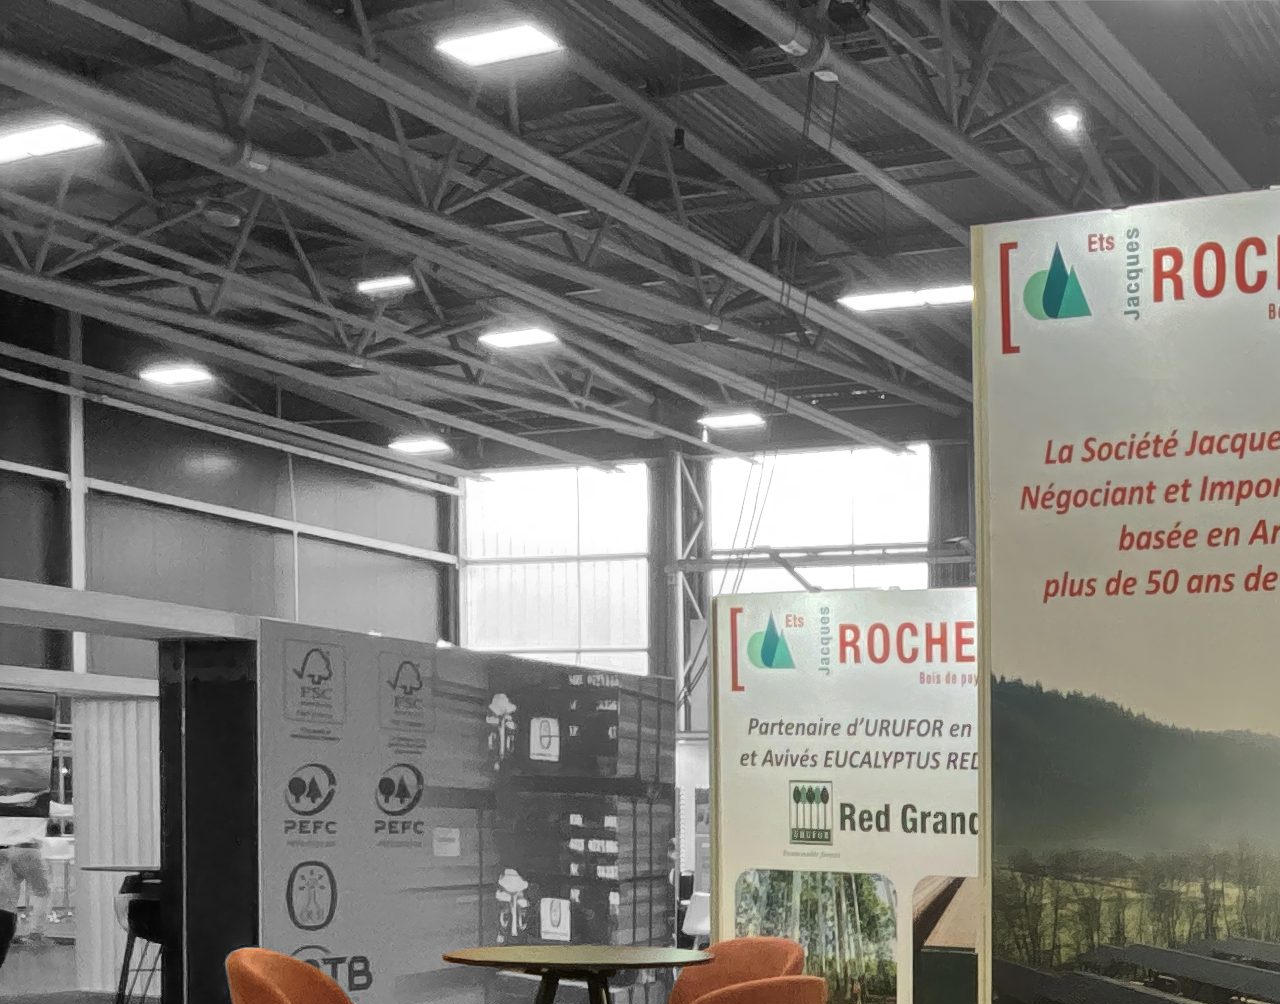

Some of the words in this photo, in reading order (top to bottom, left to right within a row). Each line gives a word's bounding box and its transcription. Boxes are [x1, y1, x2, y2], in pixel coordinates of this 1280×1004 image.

[1088, 234, 1114, 252] Ets
[1123, 228, 1143, 322] Jacques
[1045, 440, 1073, 464] La
[1081, 430, 1178, 462] Société
[1021, 480, 1156, 515] Négociant
[1164, 479, 1192, 503] et
[1119, 522, 1198, 551] basée
[1207, 527, 1240, 547] en
[1043, 571, 1096, 603] plus
[1106, 570, 1137, 596] de
[1145, 569, 1179, 595] 50
[1187, 573, 1235, 593] ans
[1244, 565, 1278, 592] de
[786, 614, 804, 628] Ets
[818, 607, 832, 677] Jacques
[920, 672, 941, 684] Bois
[945, 672, 957, 684] de
[748, 718, 841, 736] Partenaire
[950, 724, 971, 737] en
[740, 750, 758, 766] et
[761, 748, 818, 767] Avivés
[824, 750, 941, 770] EUCALYPTUS
[284, 820, 337, 834] PEFC
[375, 820, 424, 836] PEFC
[840, 803, 890, 832] Red
[304, 956, 373, 992] TB
